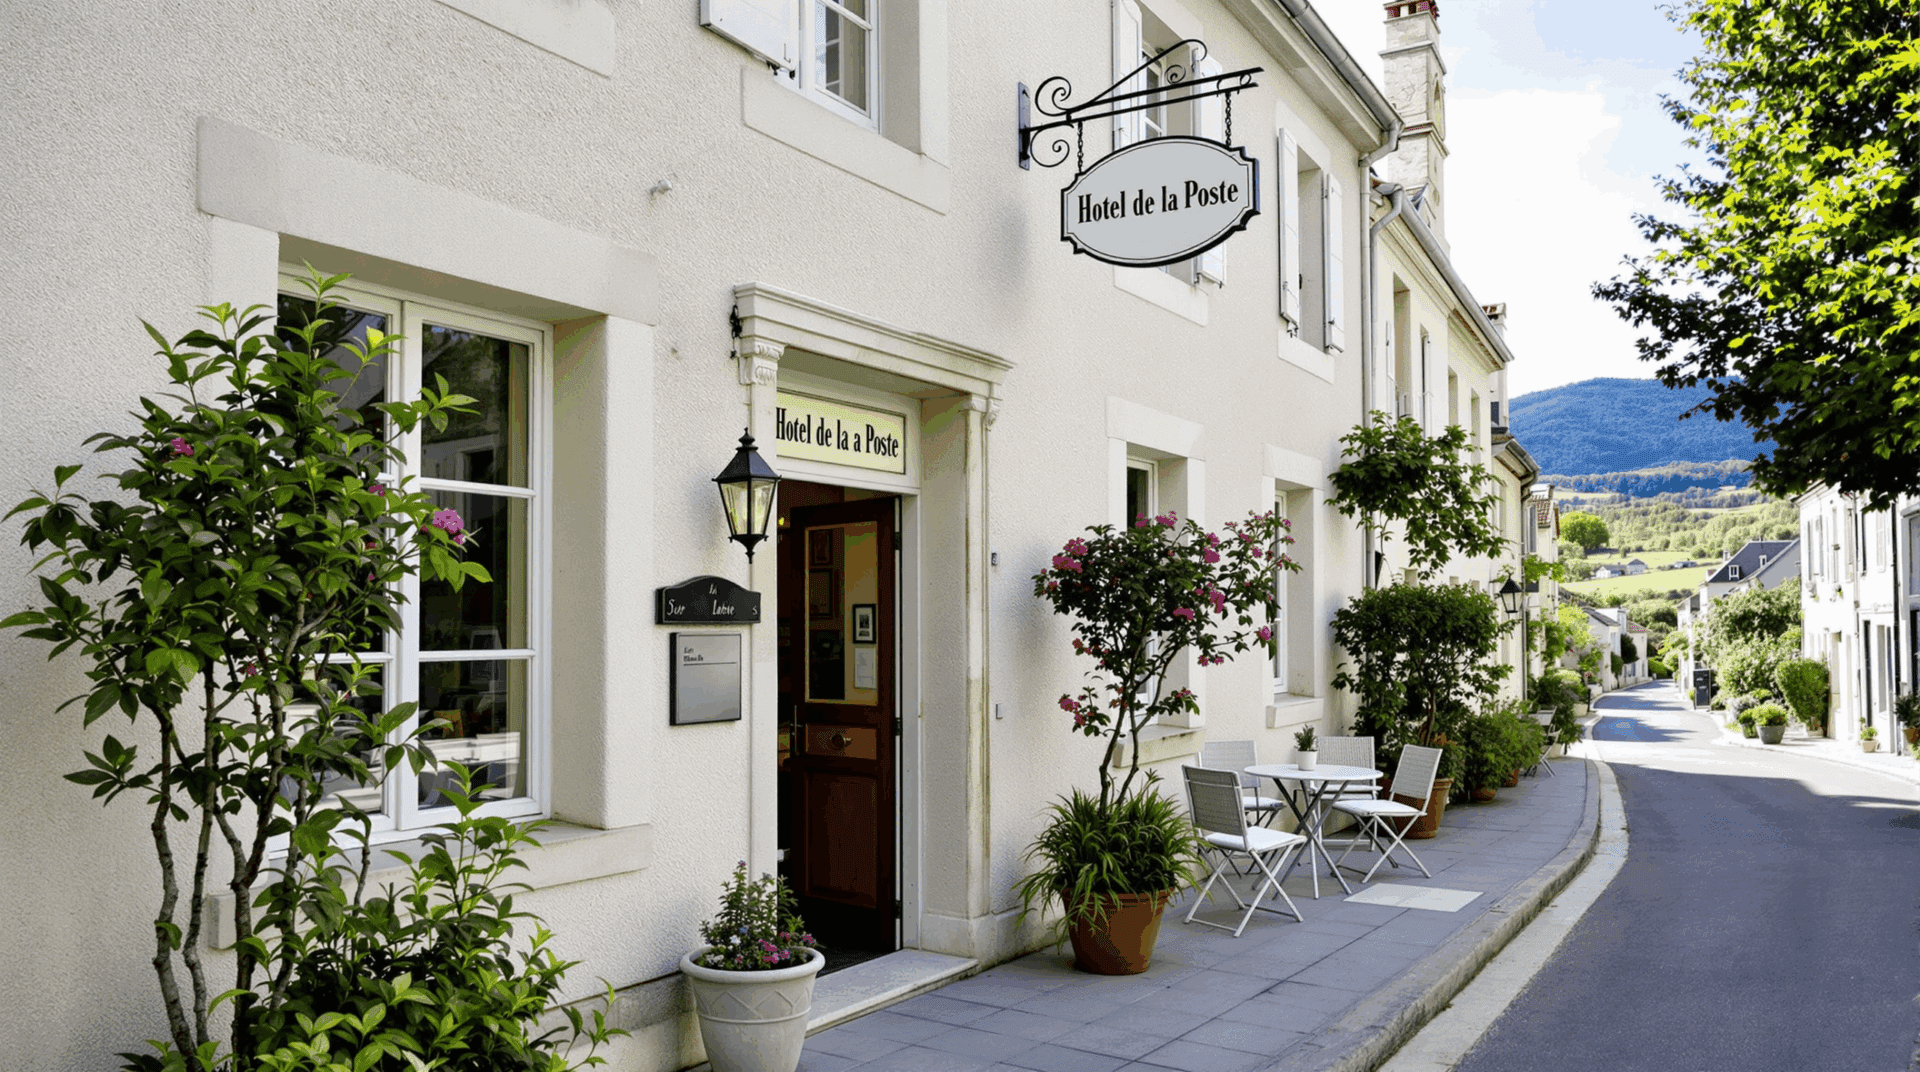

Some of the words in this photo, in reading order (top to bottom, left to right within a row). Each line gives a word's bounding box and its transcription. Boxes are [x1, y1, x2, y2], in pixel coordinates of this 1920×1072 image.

[1078, 191, 1126, 224] Hotel
[1133, 189, 1155, 217] de
[1161, 186, 1178, 213] la
[1184, 180, 1239, 209] Poste
[776, 407, 811, 444] Hotel
[816, 417, 832, 447] de
[837, 419, 849, 451] la
[853, 433, 861, 453] a
[866, 424, 899, 458] Poste
